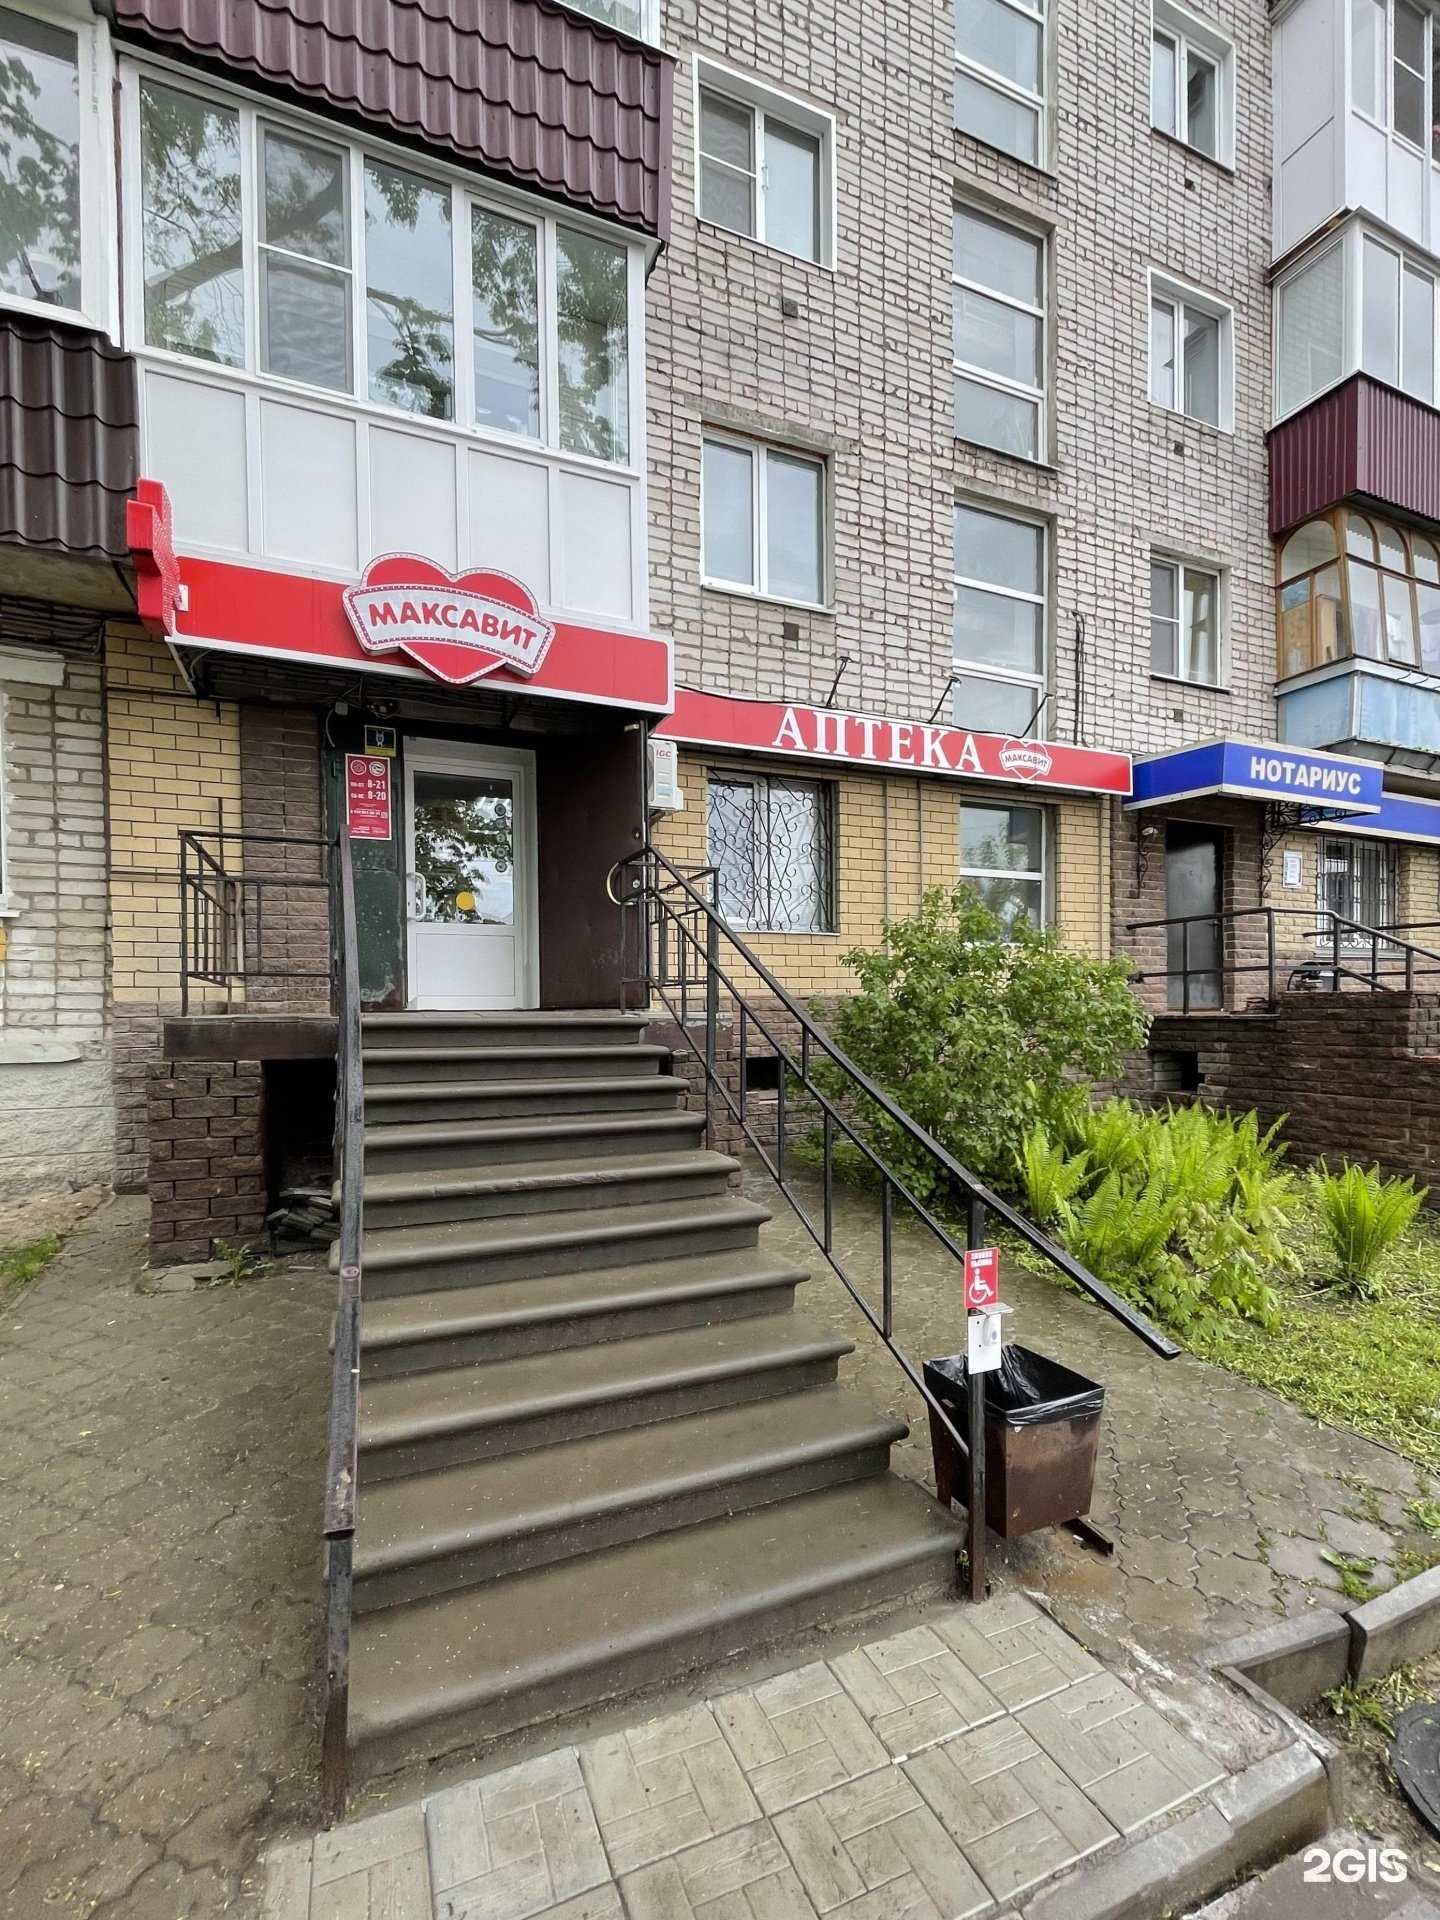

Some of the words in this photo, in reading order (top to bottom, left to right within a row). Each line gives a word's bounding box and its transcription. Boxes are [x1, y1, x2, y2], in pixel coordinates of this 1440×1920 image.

[368, 601, 538, 650] МАКСАВИТ
[656, 749, 672, 758] IGC
[771, 707, 985, 773] АПТЕКА
[1004, 753, 1048, 768] МАКСАВИТ
[1250, 756, 1362, 795] НОТАРИУС
